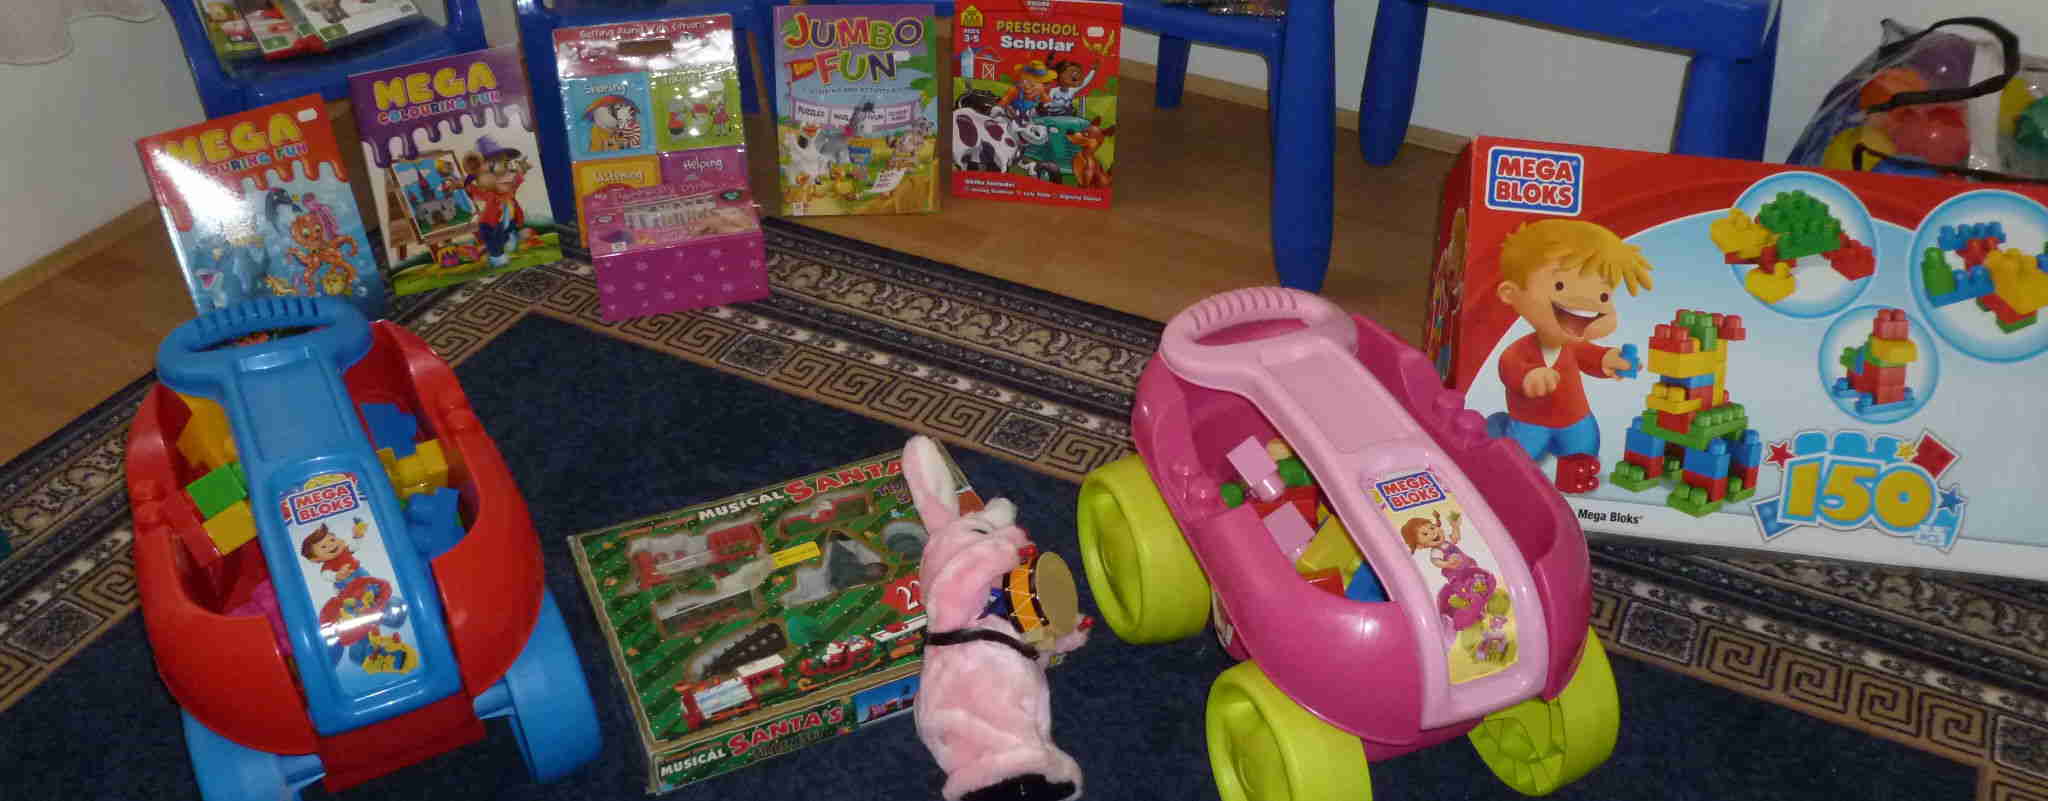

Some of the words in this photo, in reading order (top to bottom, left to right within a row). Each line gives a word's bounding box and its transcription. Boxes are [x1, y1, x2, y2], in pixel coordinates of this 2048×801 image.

[784, 12, 925, 50] JUMBO
[996, 20, 1080, 36] PRESCHOOL
[1001, 35, 1075, 52] Scholar
[815, 47, 898, 86] FUN
[372, 61, 497, 111] MEGA
[376, 97, 466, 125] COLOURING
[163, 112, 302, 166] MEGA
[683, 155, 724, 173] Helping
[1497, 155, 1575, 183] MEGA
[1495, 179, 1574, 208] BLOKS
[295, 484, 351, 507] MEGA
[1383, 476, 1432, 496] MEGA
[1391, 487, 1440, 507] BLOKS
[1780, 459, 1937, 533] 150
[300, 496, 353, 521] BLOKS
[699, 491, 784, 520] MUSICAL
[1578, 509, 1607, 523] Mega
[661, 748, 727, 777] MUSICAL
[727, 706, 845, 757] SANTA'S
